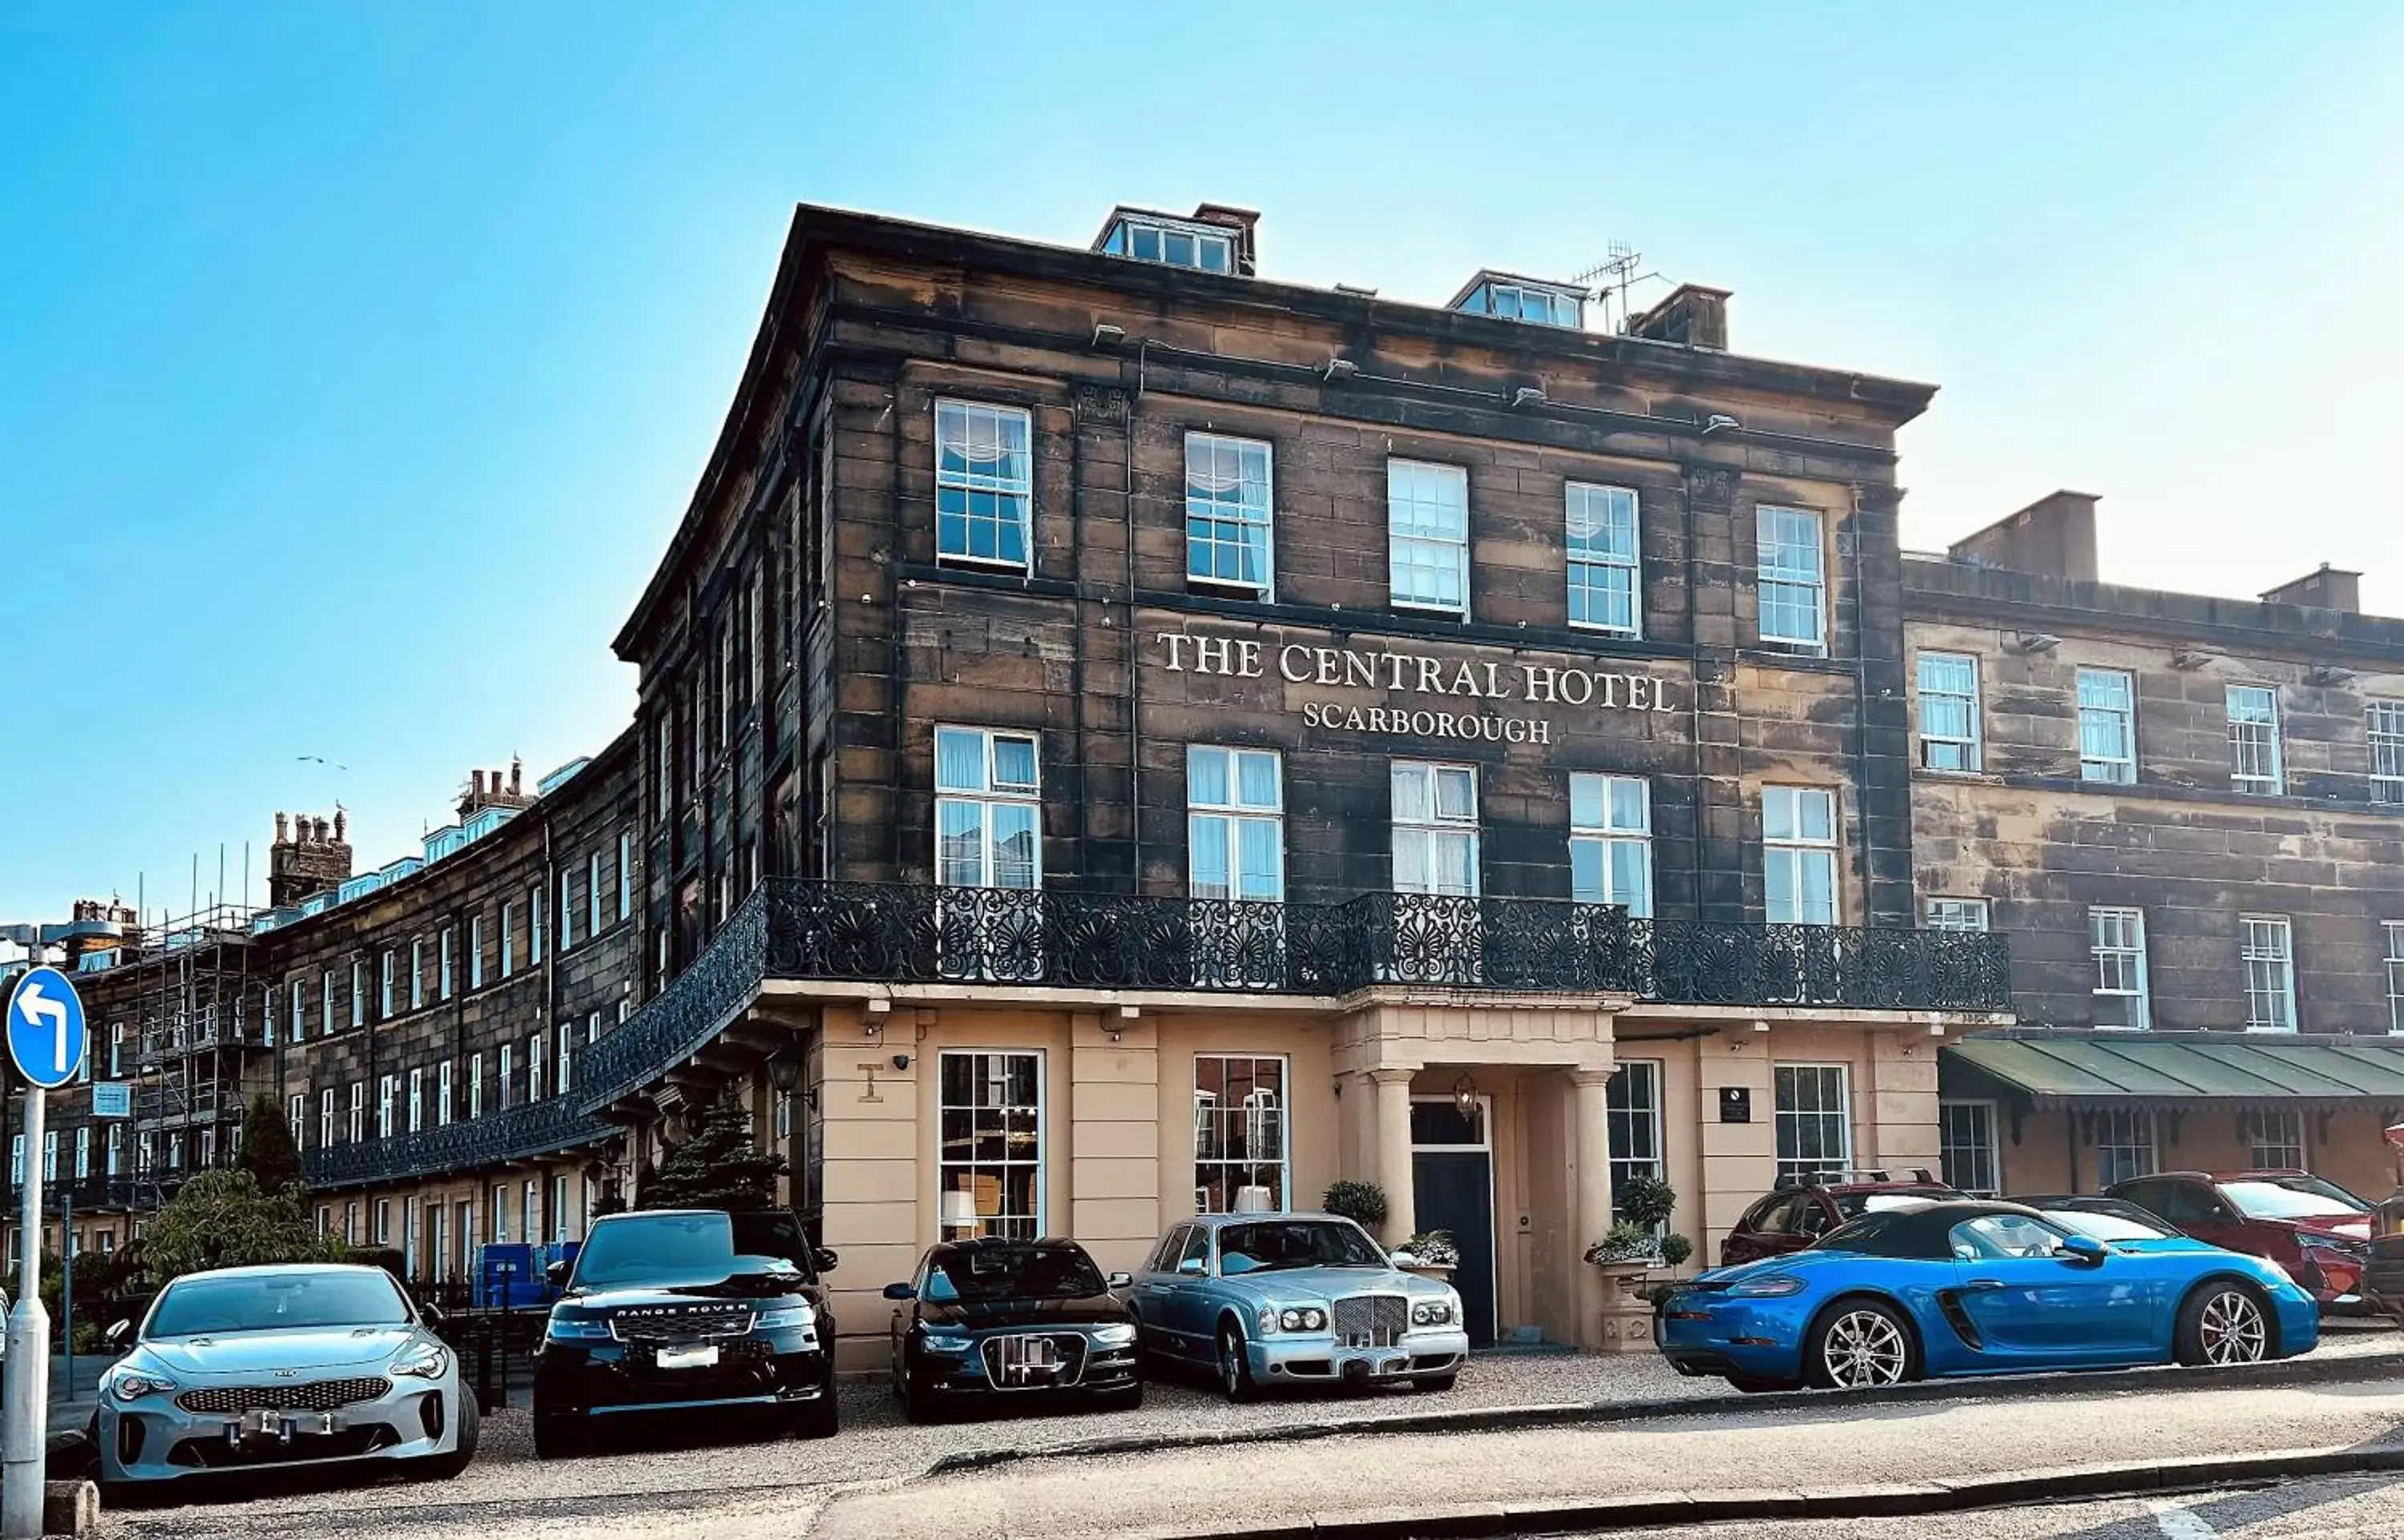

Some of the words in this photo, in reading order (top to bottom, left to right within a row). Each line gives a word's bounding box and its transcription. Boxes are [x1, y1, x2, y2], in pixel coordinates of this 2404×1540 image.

[1156, 632, 1264, 678] THE
[1280, 643, 1511, 699] CENTRAL
[1523, 666, 1676, 712] HOTEL
[1303, 702, 1551, 744] SCARBOROUGH
[616, 1308, 677, 1317] RANGE
[688, 1303, 748, 1314] ROVER
